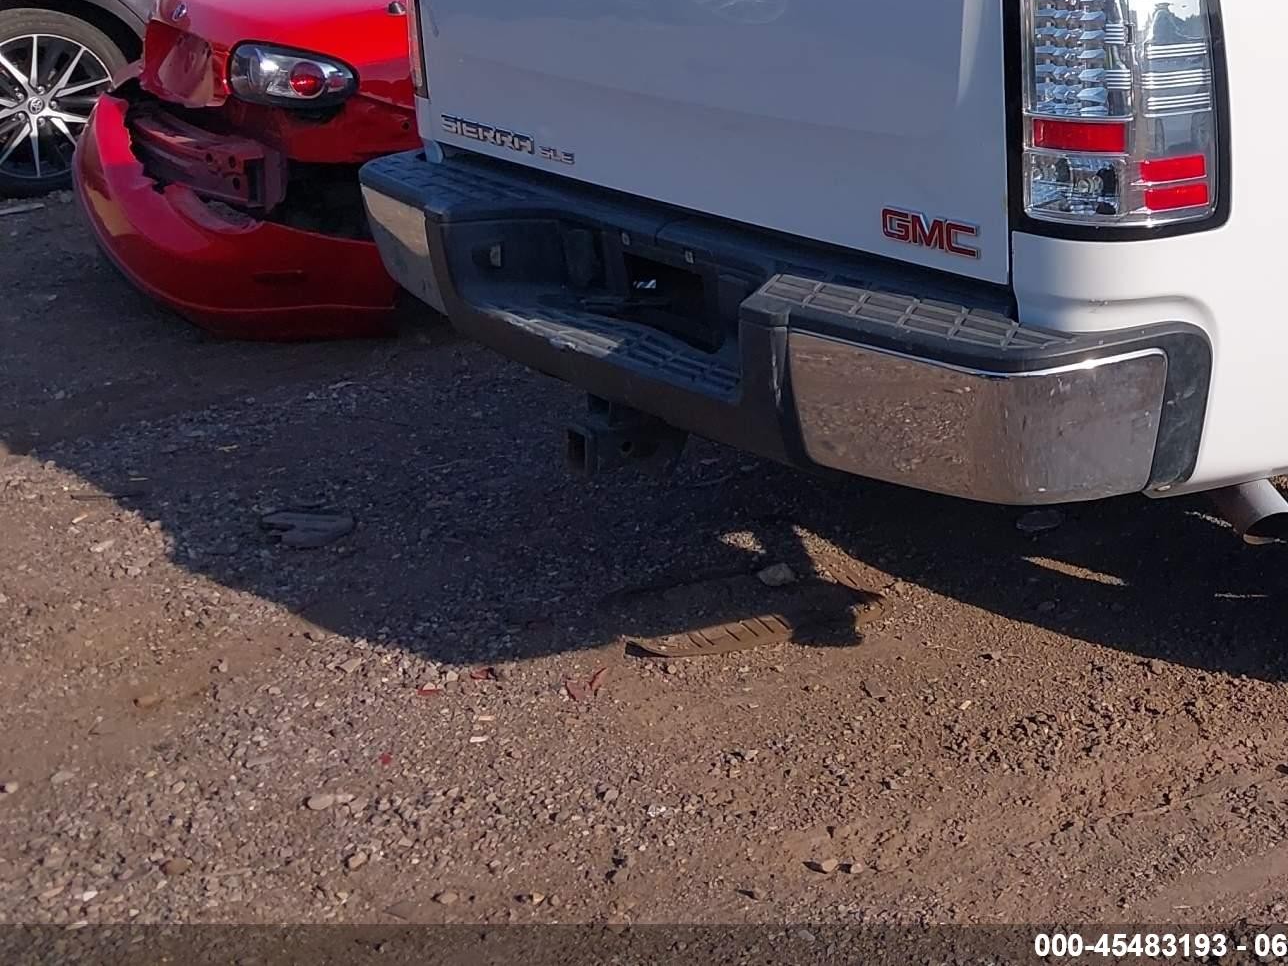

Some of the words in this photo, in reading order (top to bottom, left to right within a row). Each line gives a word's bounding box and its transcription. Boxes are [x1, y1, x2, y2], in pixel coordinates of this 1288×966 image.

[440, 113, 535, 155] SIERRA
[539, 145, 576, 165] SLE
[880, 205, 980, 260] GMC
